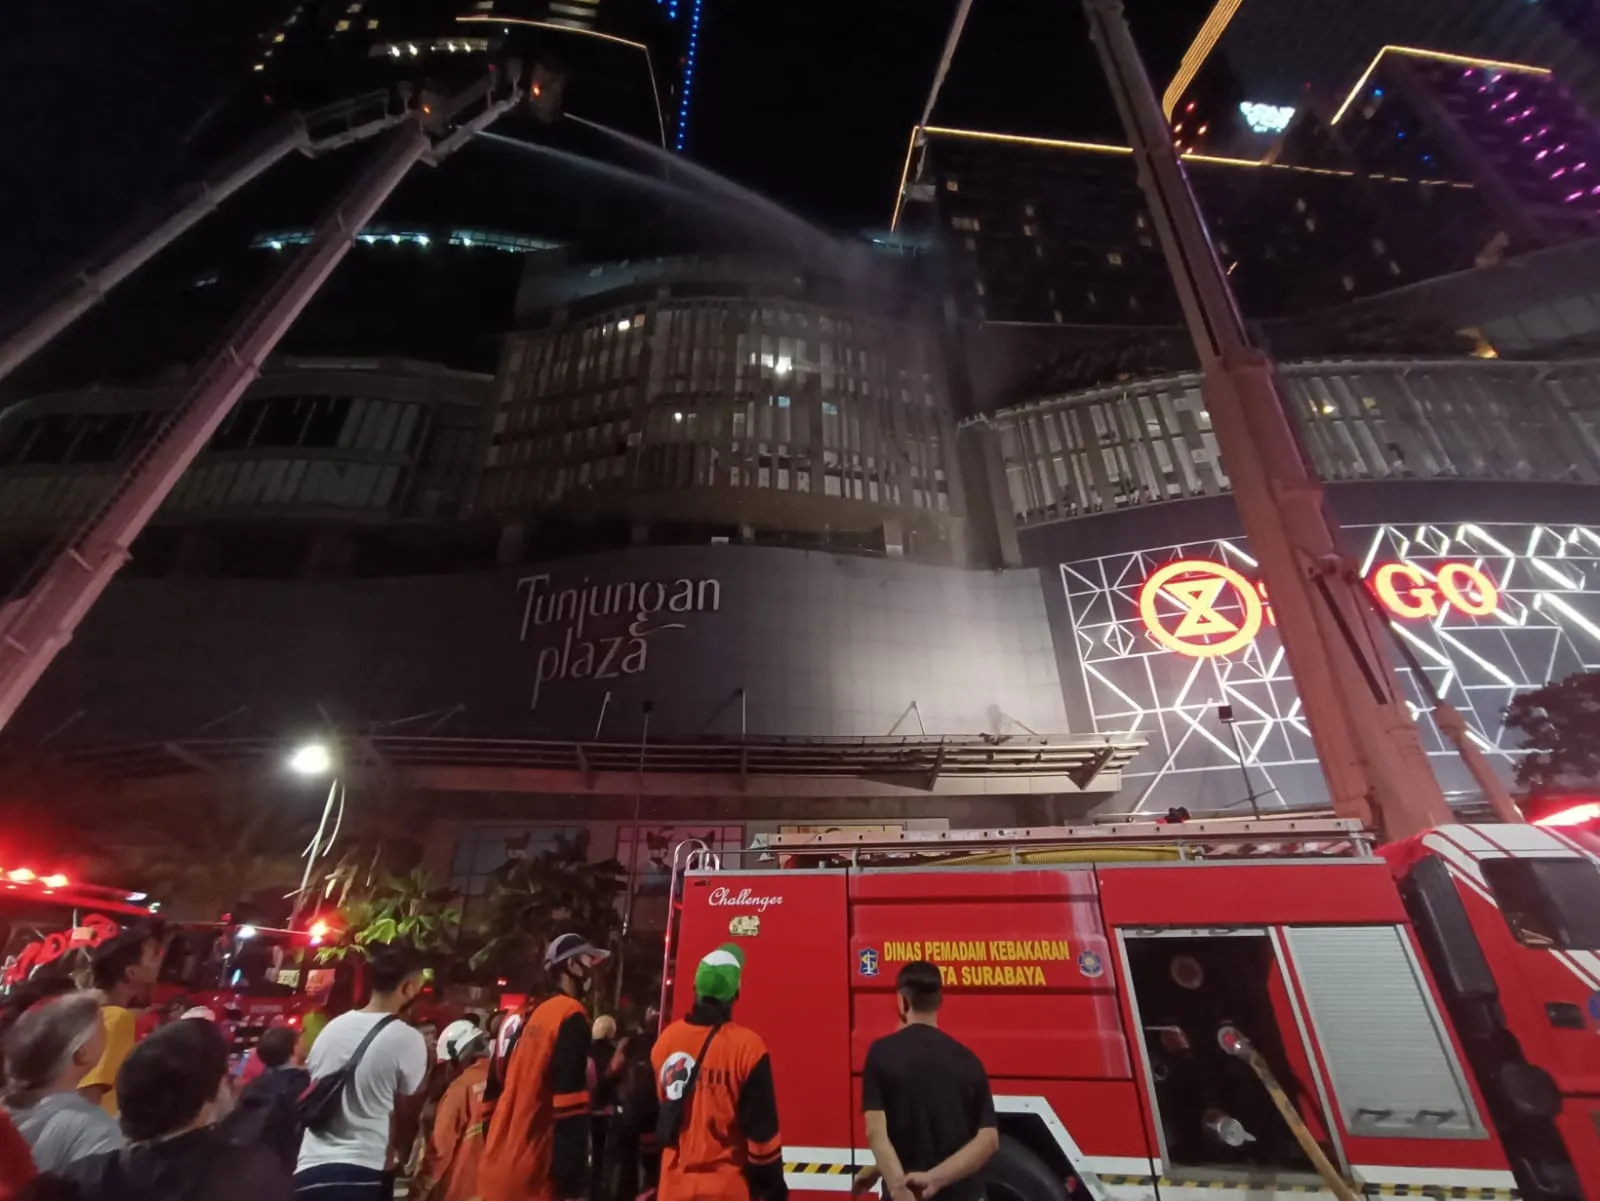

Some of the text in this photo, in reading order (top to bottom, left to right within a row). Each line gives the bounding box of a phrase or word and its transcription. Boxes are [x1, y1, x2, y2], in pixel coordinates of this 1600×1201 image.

[517, 573, 720, 641] Tunjungan
[530, 626, 648, 710] plaza
[708, 886, 784, 912] Challenger
[883, 940, 1070, 961] DINAS PEMADAM KEBAKARAN
[962, 966, 1047, 985] SURABAYA
